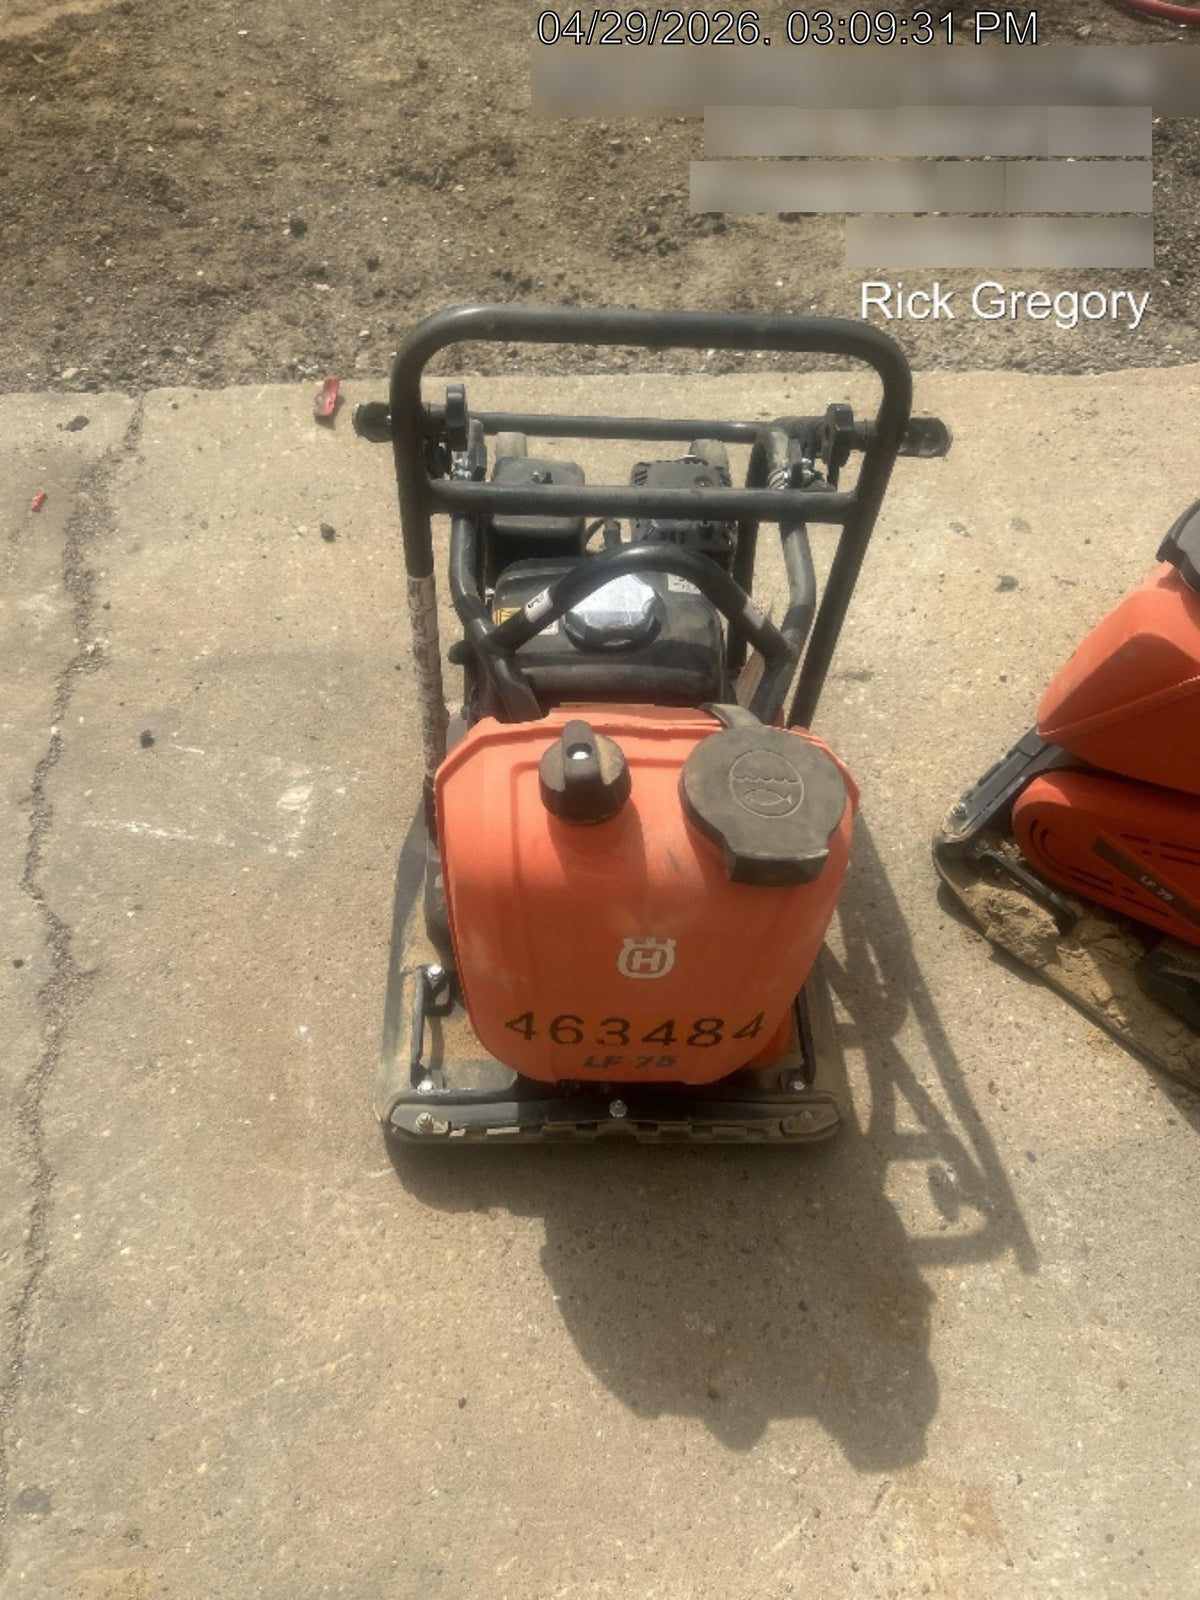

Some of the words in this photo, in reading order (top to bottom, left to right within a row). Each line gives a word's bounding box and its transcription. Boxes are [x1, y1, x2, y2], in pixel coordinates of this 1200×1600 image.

[504, 1010, 766, 1048] 463484
[583, 1055, 624, 1068] LF
[634, 1054, 678, 1067] 75
